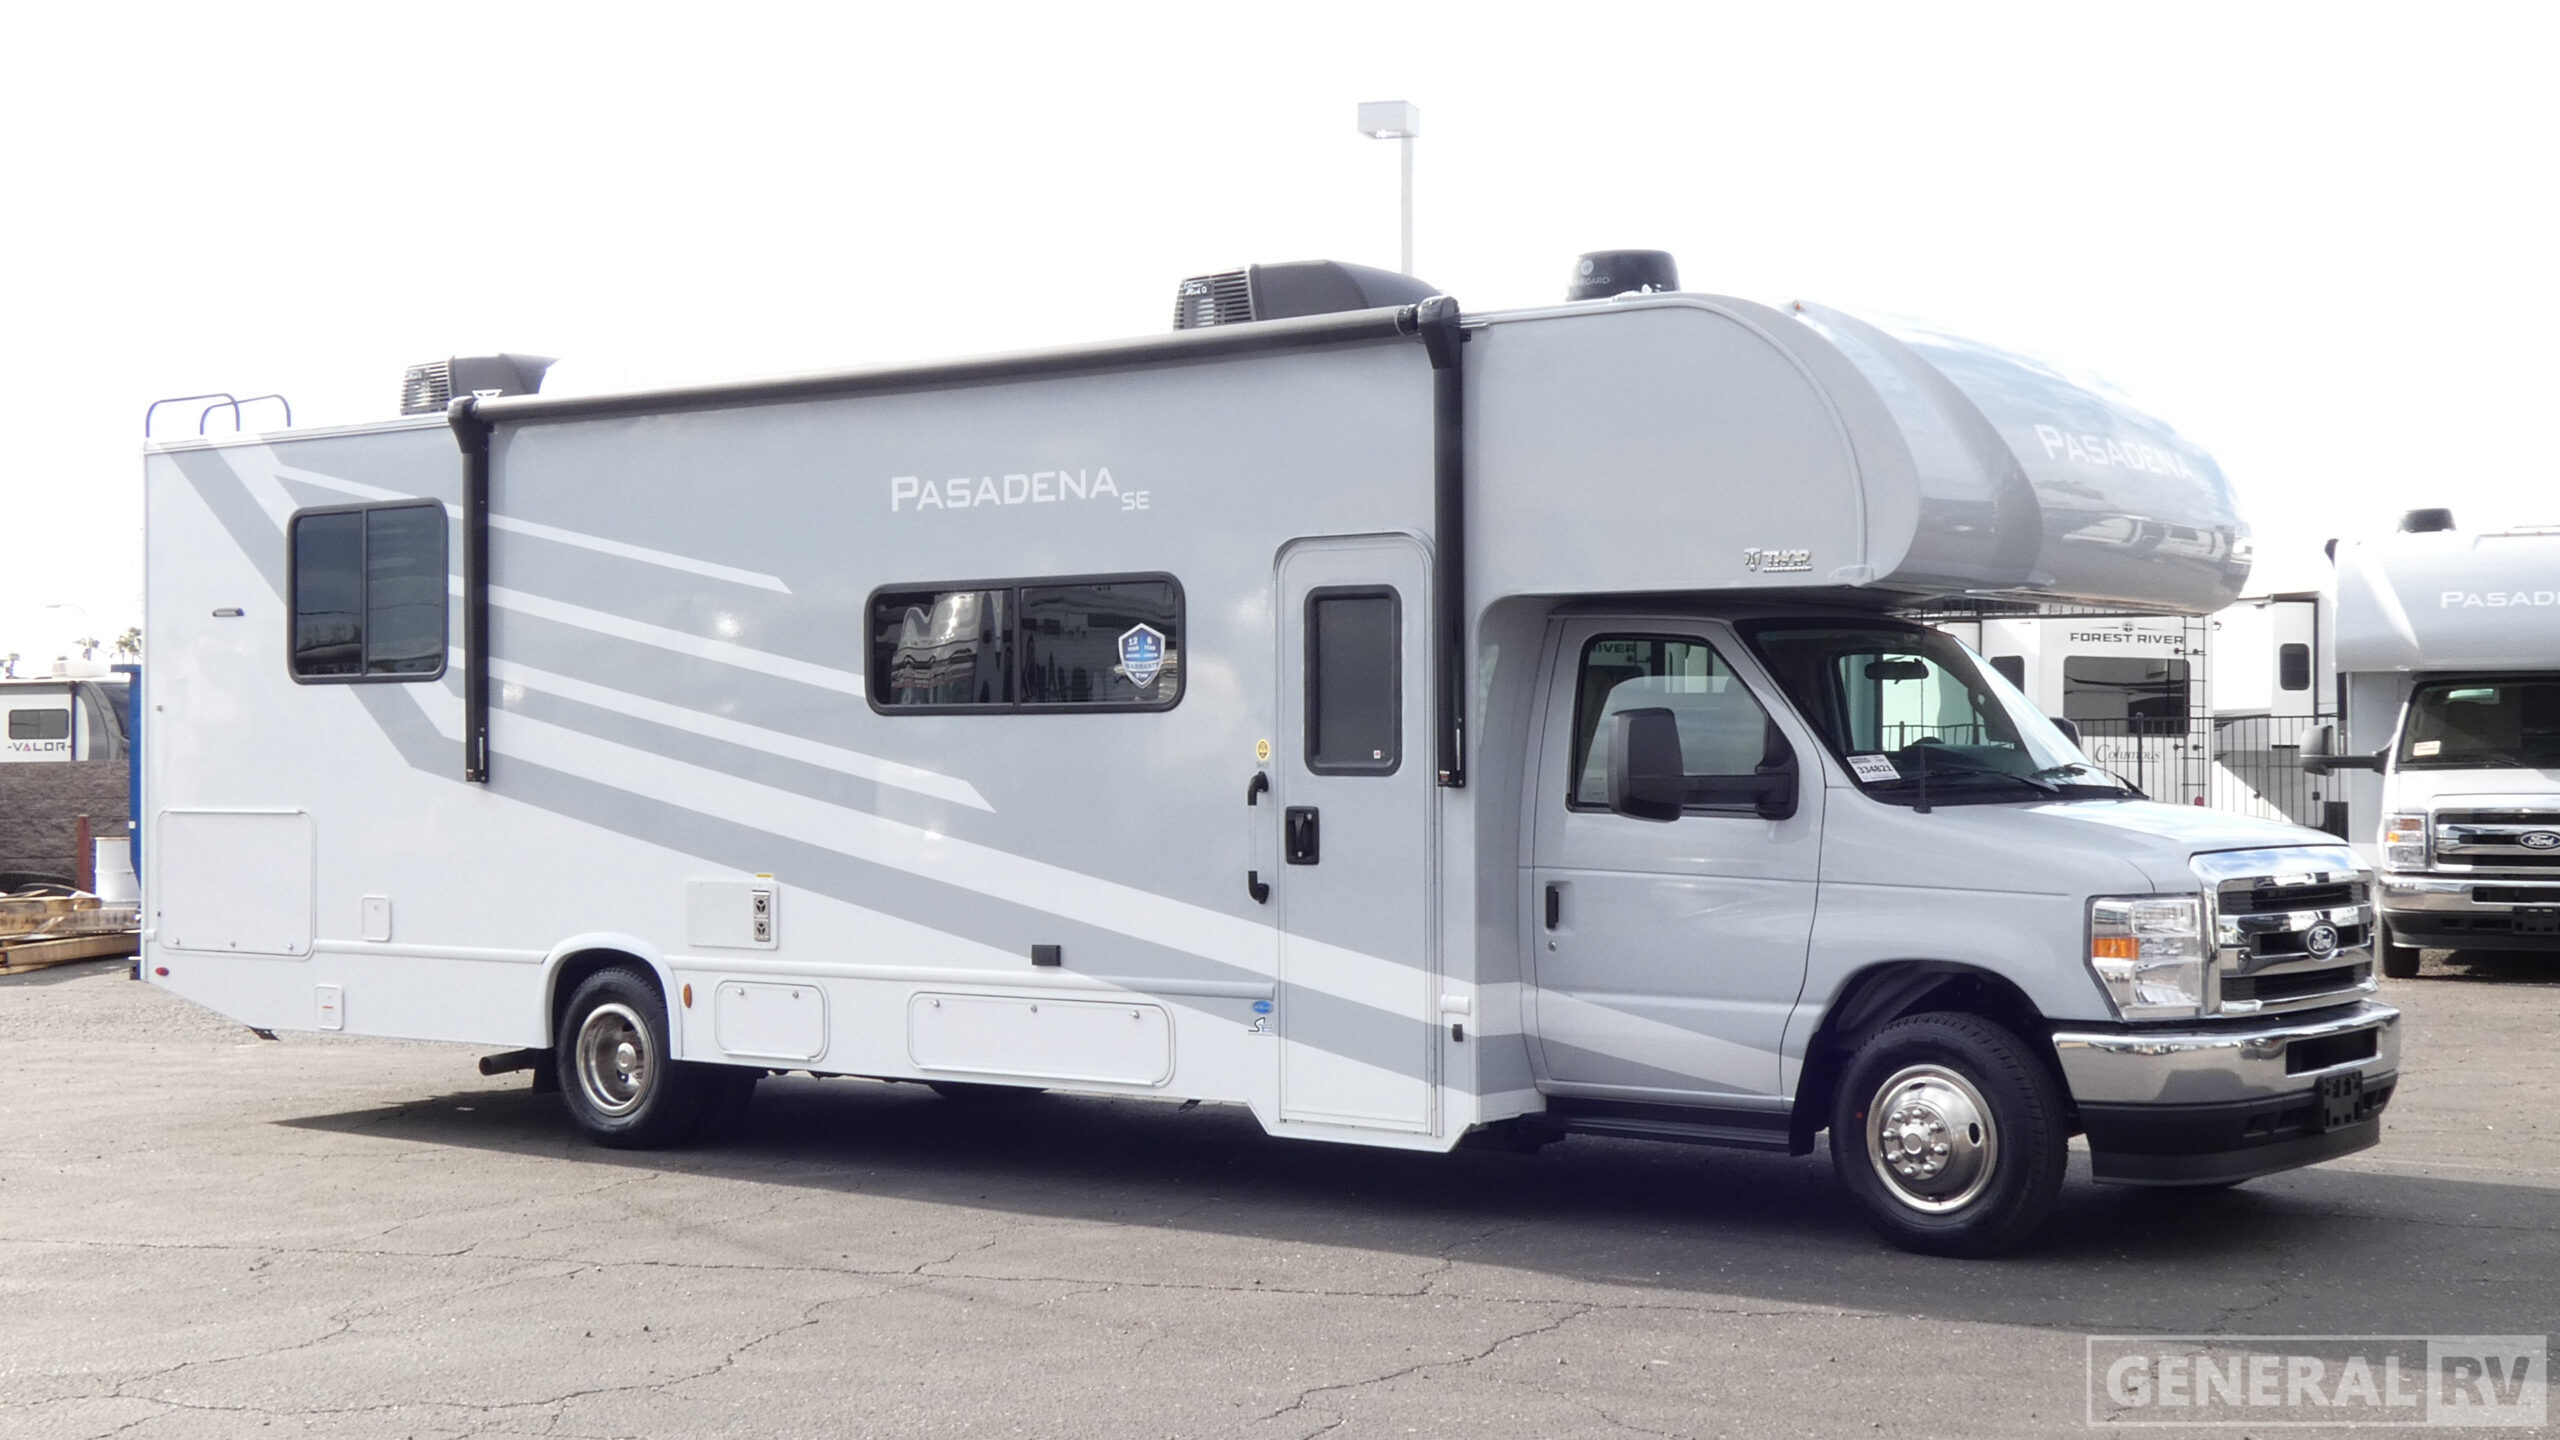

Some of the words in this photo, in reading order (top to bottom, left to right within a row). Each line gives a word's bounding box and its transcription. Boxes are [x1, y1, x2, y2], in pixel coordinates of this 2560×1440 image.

[2033, 423, 2195, 480] PASADENA
[891, 467, 1120, 512] PASADENA
[1121, 490, 1149, 511] SE
[1762, 549, 1811, 567] THOR
[2070, 632, 2133, 643] FOREST
[2137, 634, 2184, 645] RIVER
[2526, 834, 2555, 846] Ford
[2312, 928, 2333, 950] Ford
